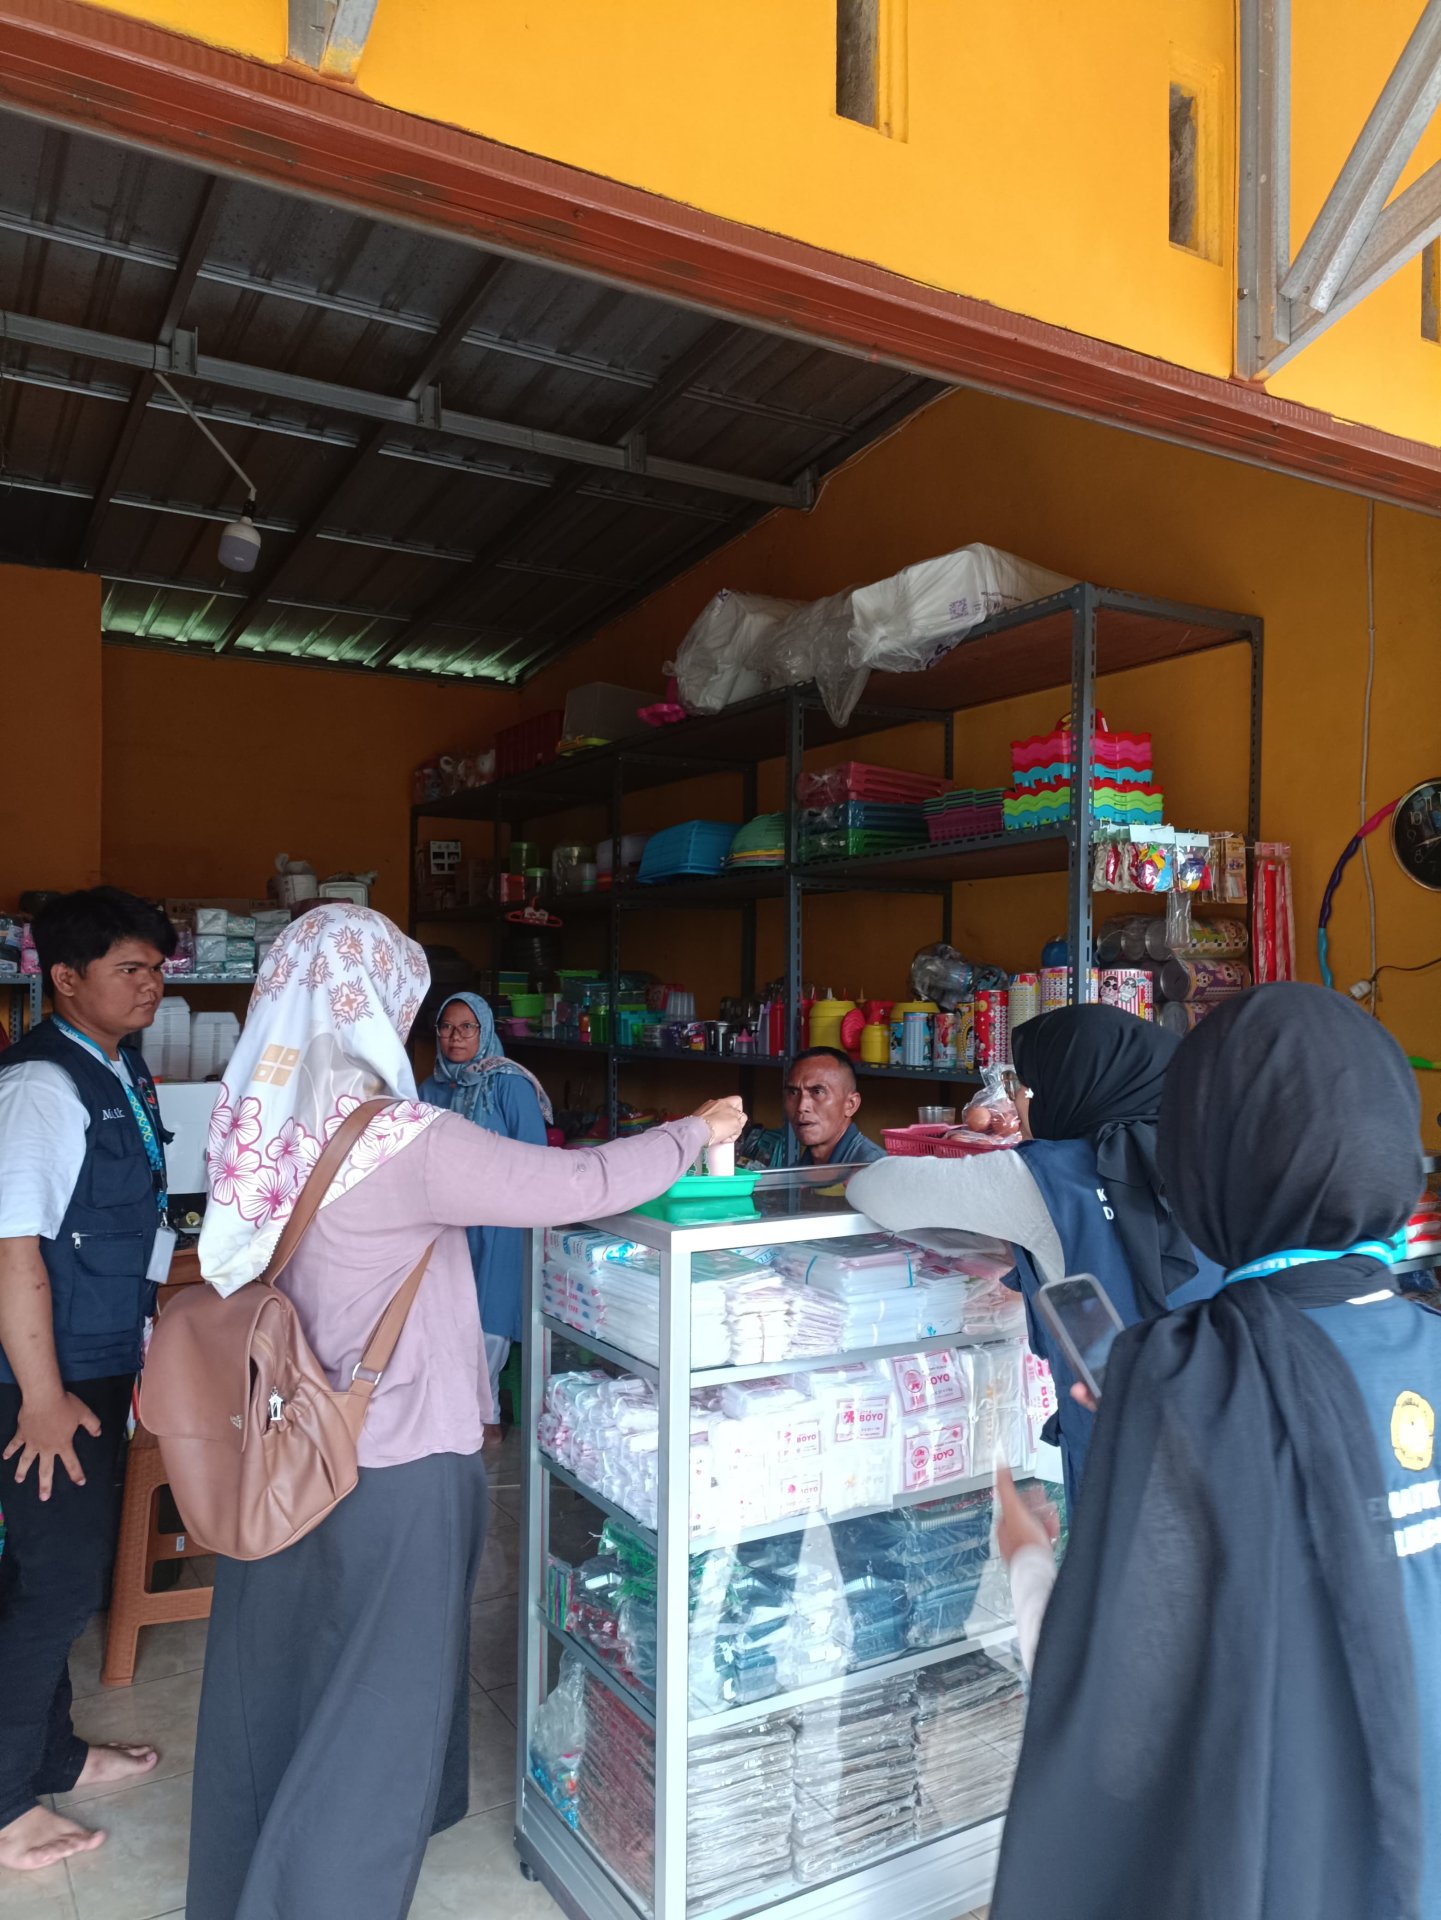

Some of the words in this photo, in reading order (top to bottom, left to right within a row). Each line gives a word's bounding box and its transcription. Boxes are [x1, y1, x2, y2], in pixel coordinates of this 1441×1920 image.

[1409, 811, 1423, 825] 10
[1407, 829, 1417, 840] 9
[1414, 849, 1423, 864] 8
[859, 1412, 884, 1423] BOYO
[796, 1434, 817, 1444] BOYO
